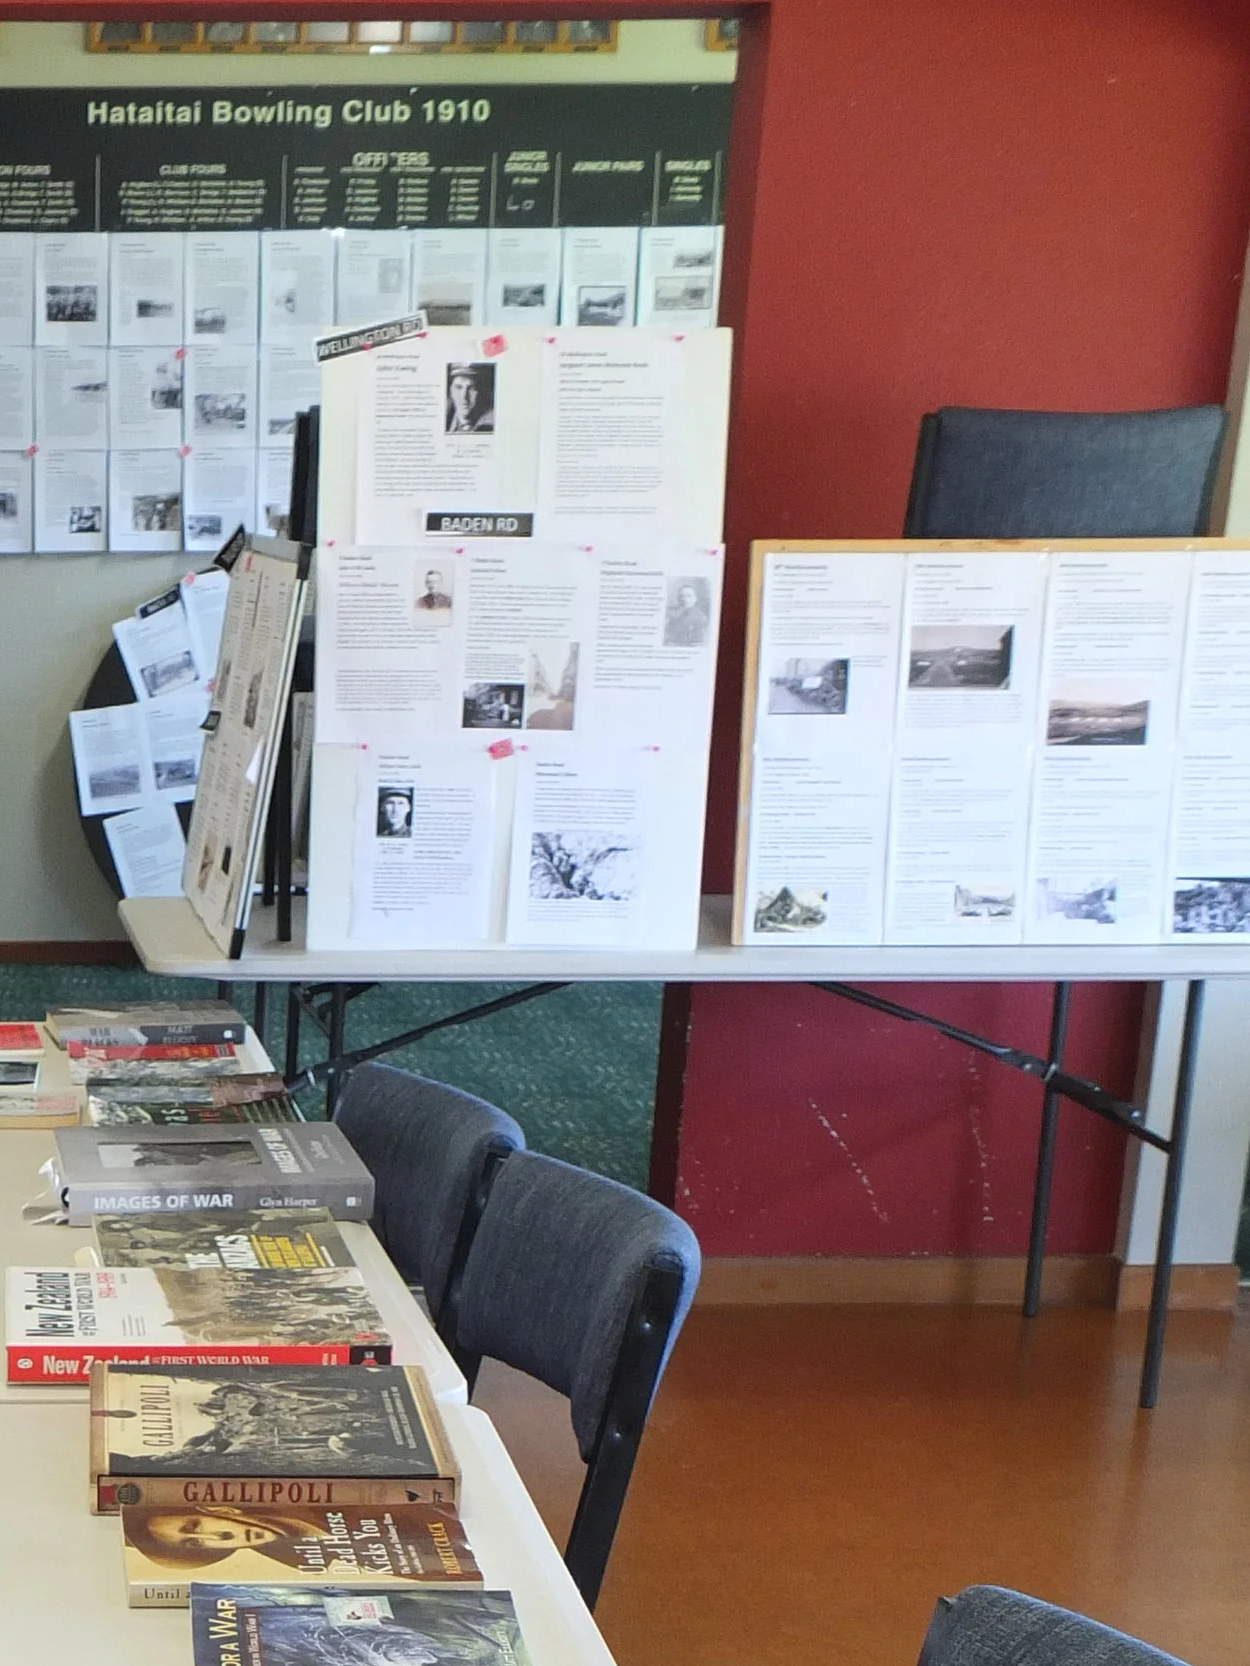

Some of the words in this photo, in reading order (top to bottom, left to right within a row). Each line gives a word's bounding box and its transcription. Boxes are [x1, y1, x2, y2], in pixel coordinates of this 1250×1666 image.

[87, 101, 203, 125] Hataitai
[212, 101, 332, 127] Bowling
[341, 100, 411, 122] Club
[422, 99, 490, 123] 1910
[353, 151, 429, 167] OFFIERS
[440, 517, 493, 534] BADEN
[496, 516, 519, 533] RD
[93, 1195, 161, 1210] IMAGES
[166, 1195, 188, 1209] OF
[191, 1194, 234, 1208] WAR
[258, 1197, 283, 1210] Glyn
[285, 1197, 317, 1210] Harper
[24, 1271, 73, 1312] Zealand
[25, 1313, 74, 1338] New
[43, 1355, 79, 1375] New
[143, 1383, 170, 1448] GALLIPOLI
[183, 1481, 335, 1504] GALLIPOLI
[323, 1512, 351, 1545] Horse
[353, 1519, 381, 1540] You
[294, 1545, 327, 1574] Until
[328, 1548, 362, 1575] Dead
[360, 1543, 394, 1574] Kicks
[209, 1599, 238, 1639] WAR
[220, 1642, 239, 1651] A
